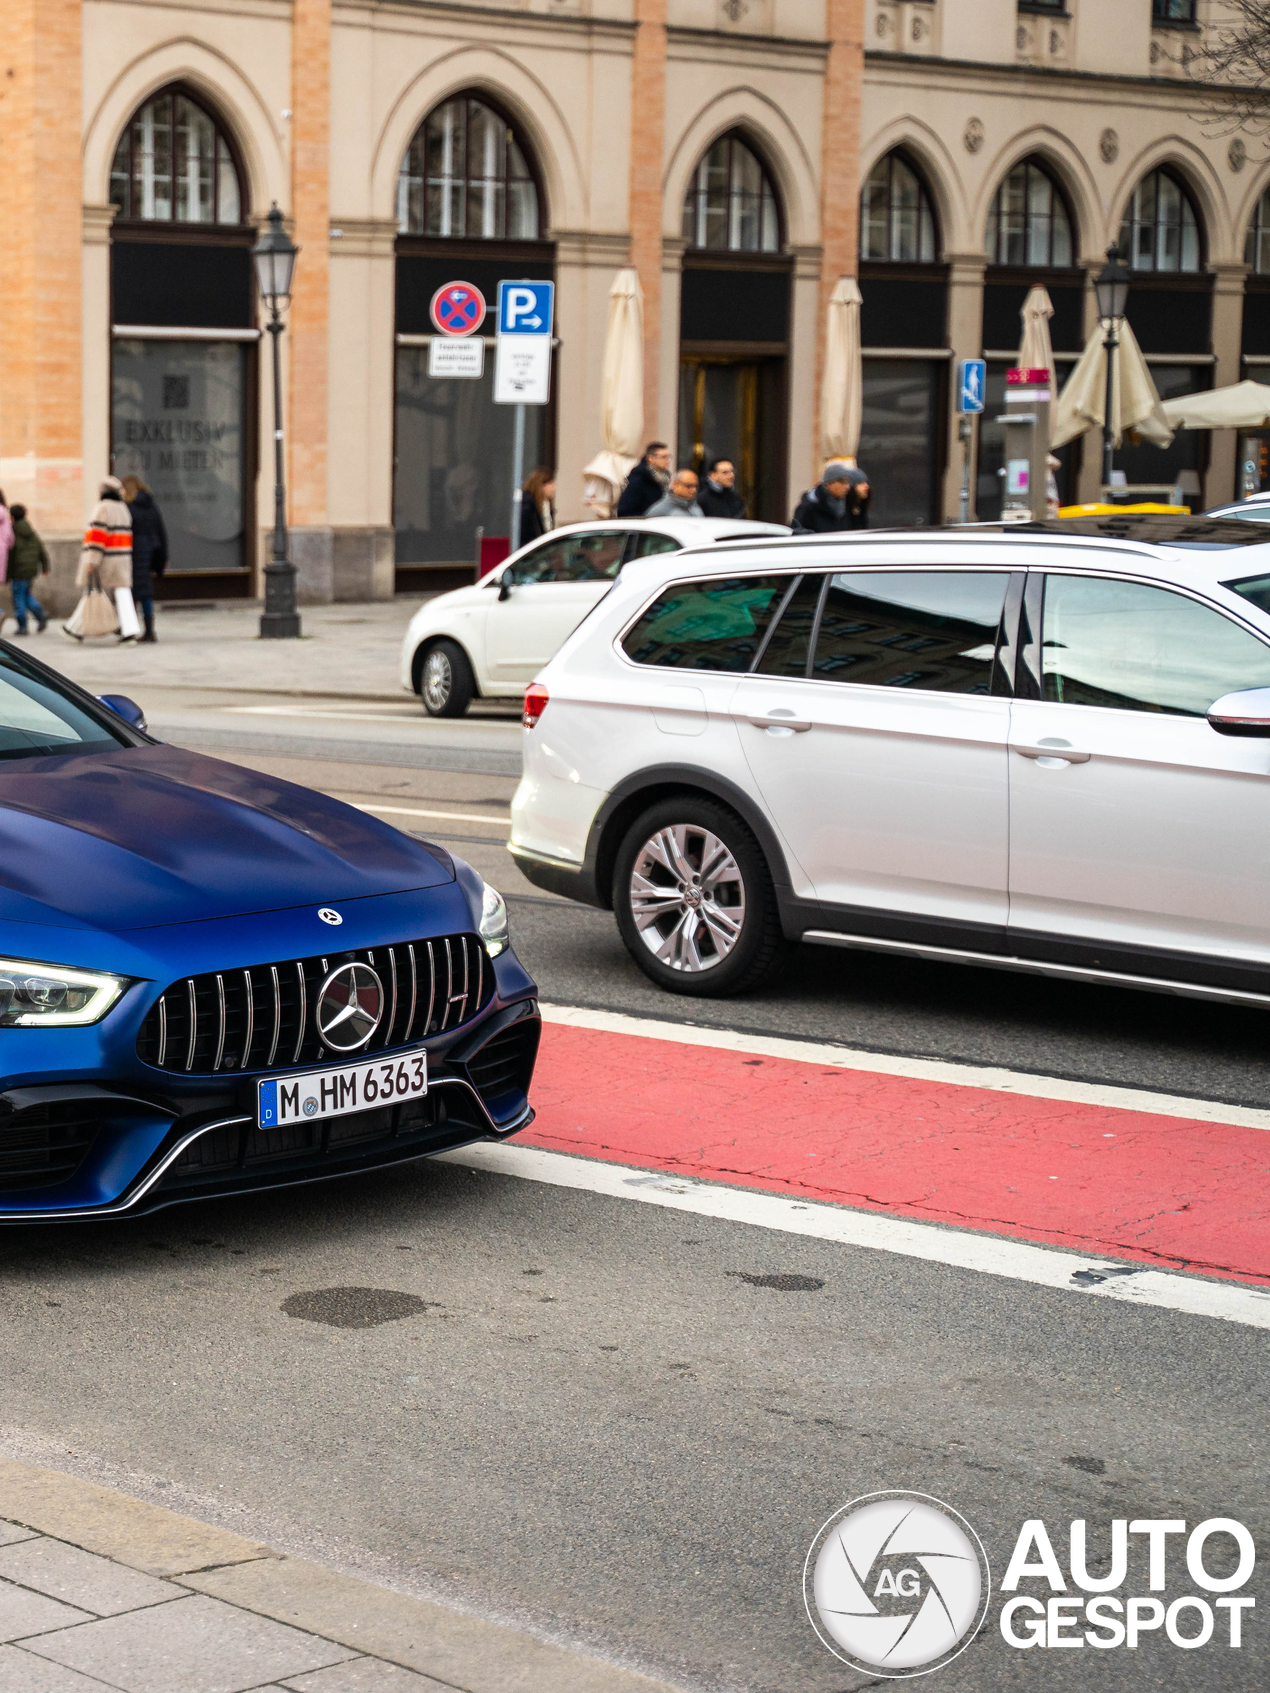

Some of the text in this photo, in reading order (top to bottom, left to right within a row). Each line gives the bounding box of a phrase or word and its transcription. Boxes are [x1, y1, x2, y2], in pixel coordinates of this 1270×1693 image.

[506, 288, 537, 329] P
[126, 420, 225, 443] EXKLUSIV
[265, 1056, 424, 1119] D M HM 6363
